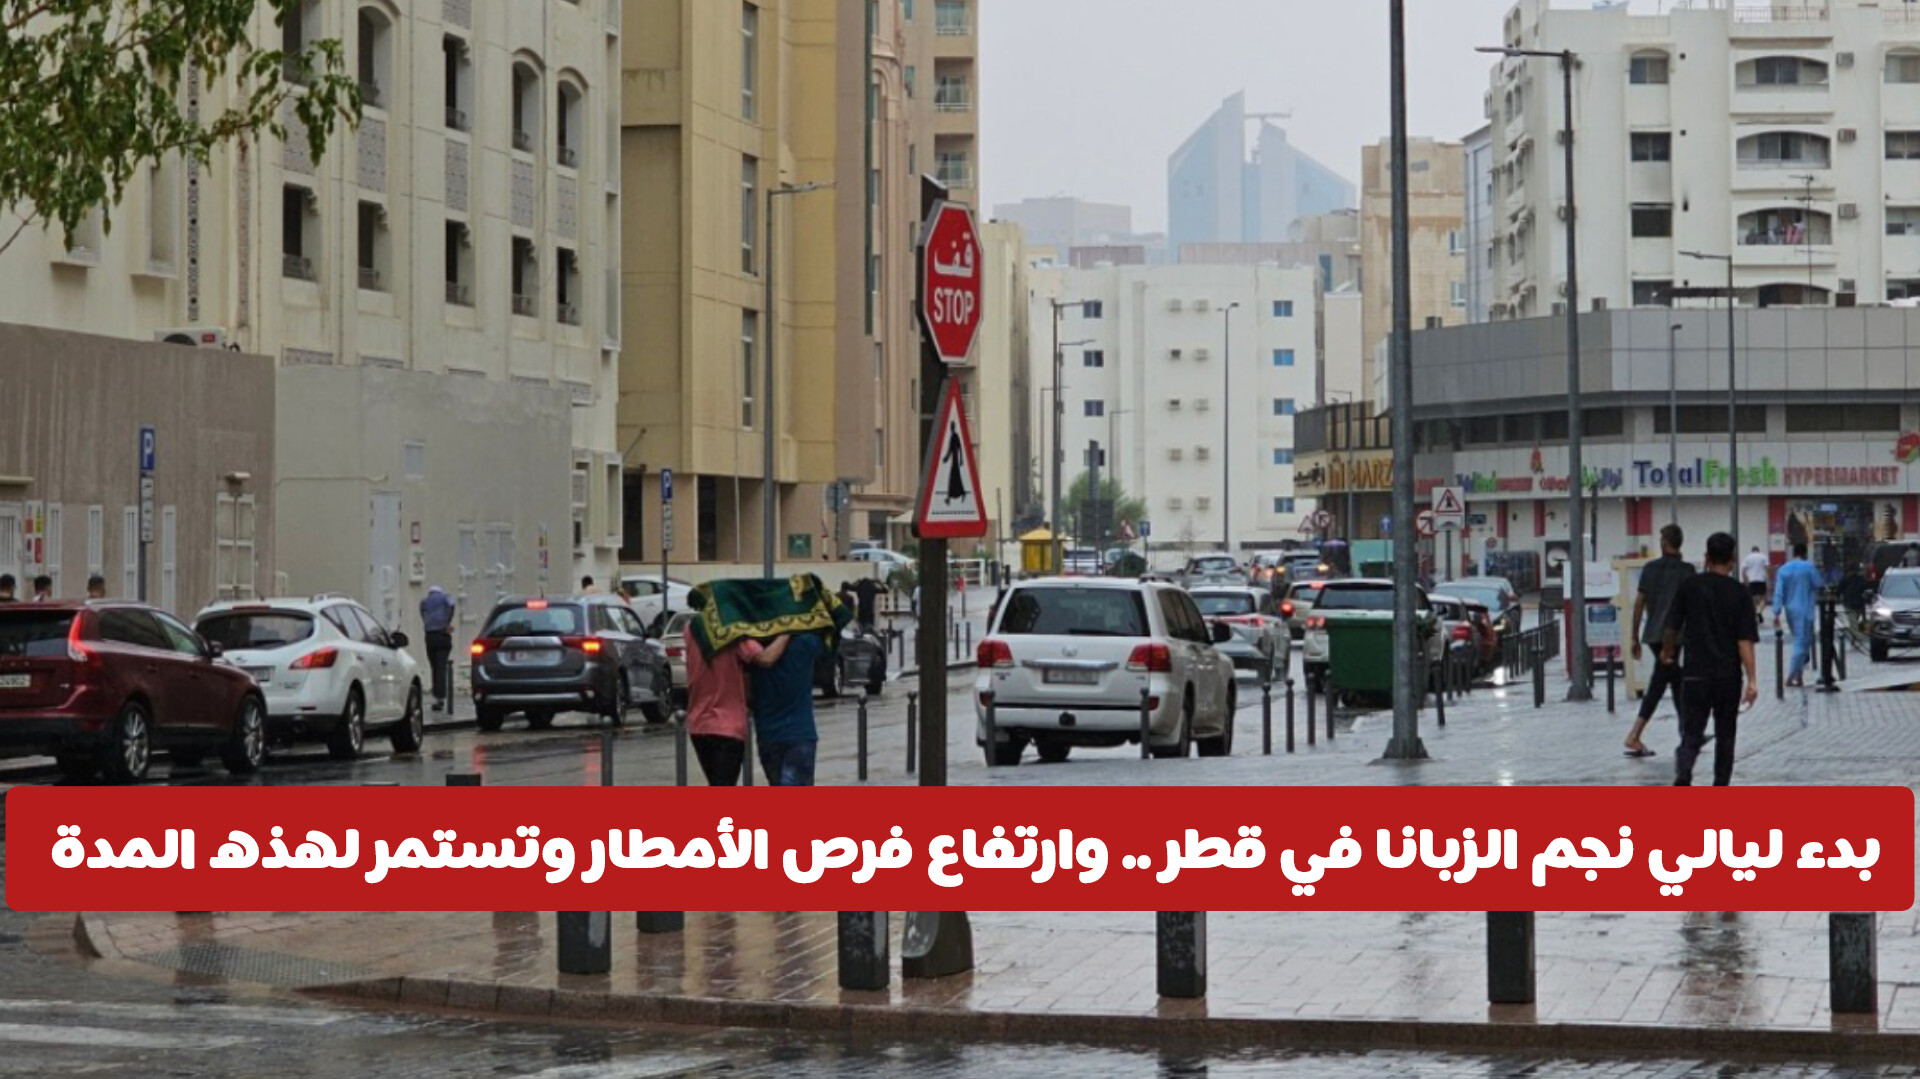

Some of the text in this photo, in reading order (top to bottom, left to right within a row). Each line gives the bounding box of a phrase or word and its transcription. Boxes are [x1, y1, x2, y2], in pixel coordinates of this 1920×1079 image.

[934, 231, 973, 277] قف
[933, 286, 974, 325] STOP
[143, 431, 154, 469] P
[1782, 465, 1899, 488] HYPERMARKET
